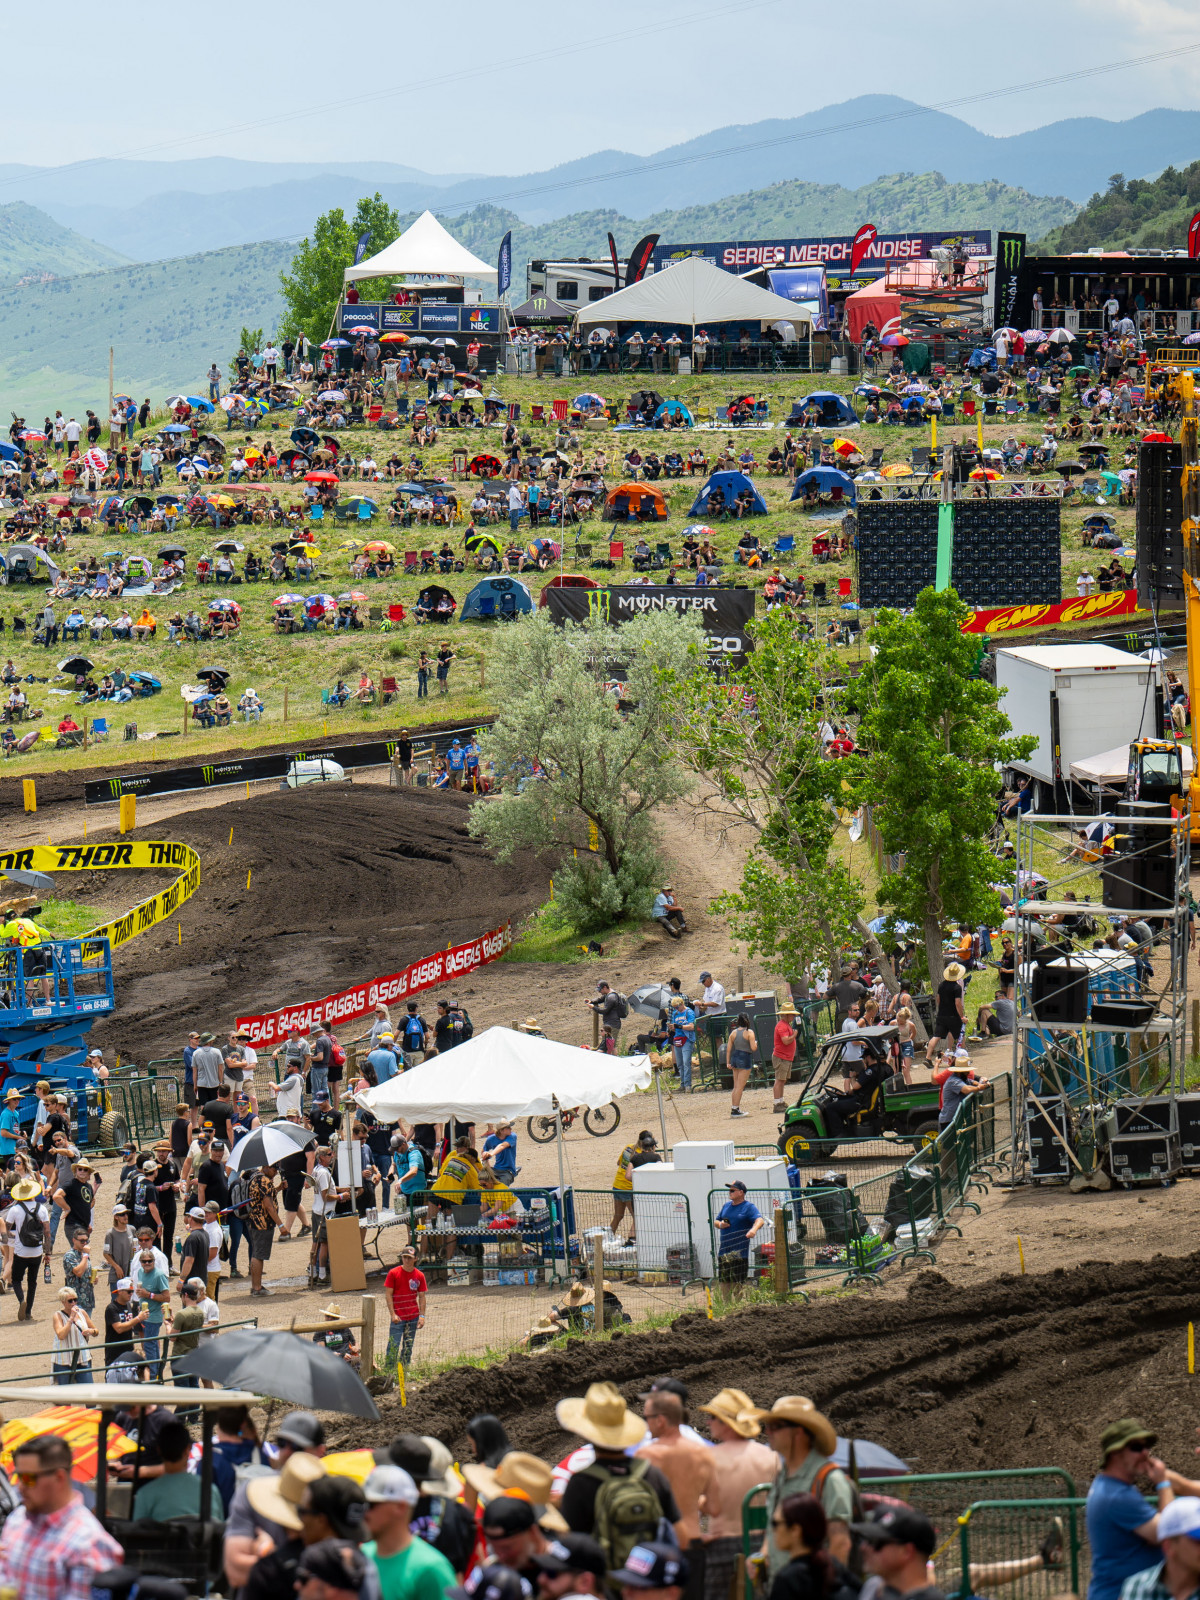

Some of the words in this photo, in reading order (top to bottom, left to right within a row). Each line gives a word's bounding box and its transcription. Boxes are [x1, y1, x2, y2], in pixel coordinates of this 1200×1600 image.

[723, 246, 786, 265] SERIES
[343, 312, 375, 323] peacock
[471, 321, 489, 330] NBC
[618, 593, 718, 611] MONSTER
[1065, 592, 1123, 622] FMF
[994, 604, 1047, 631] FMF
[214, 765, 243, 773] MONSTER
[122, 778, 151, 787] MONSTER
[56, 844, 133, 867] THOR
[148, 843, 186, 866] THOR
[325, 991, 364, 1021] GASGAS
[368, 975, 407, 1004] GASGAS
[410, 958, 442, 989] GASGAS
[445, 945, 481, 975] GASGAS
